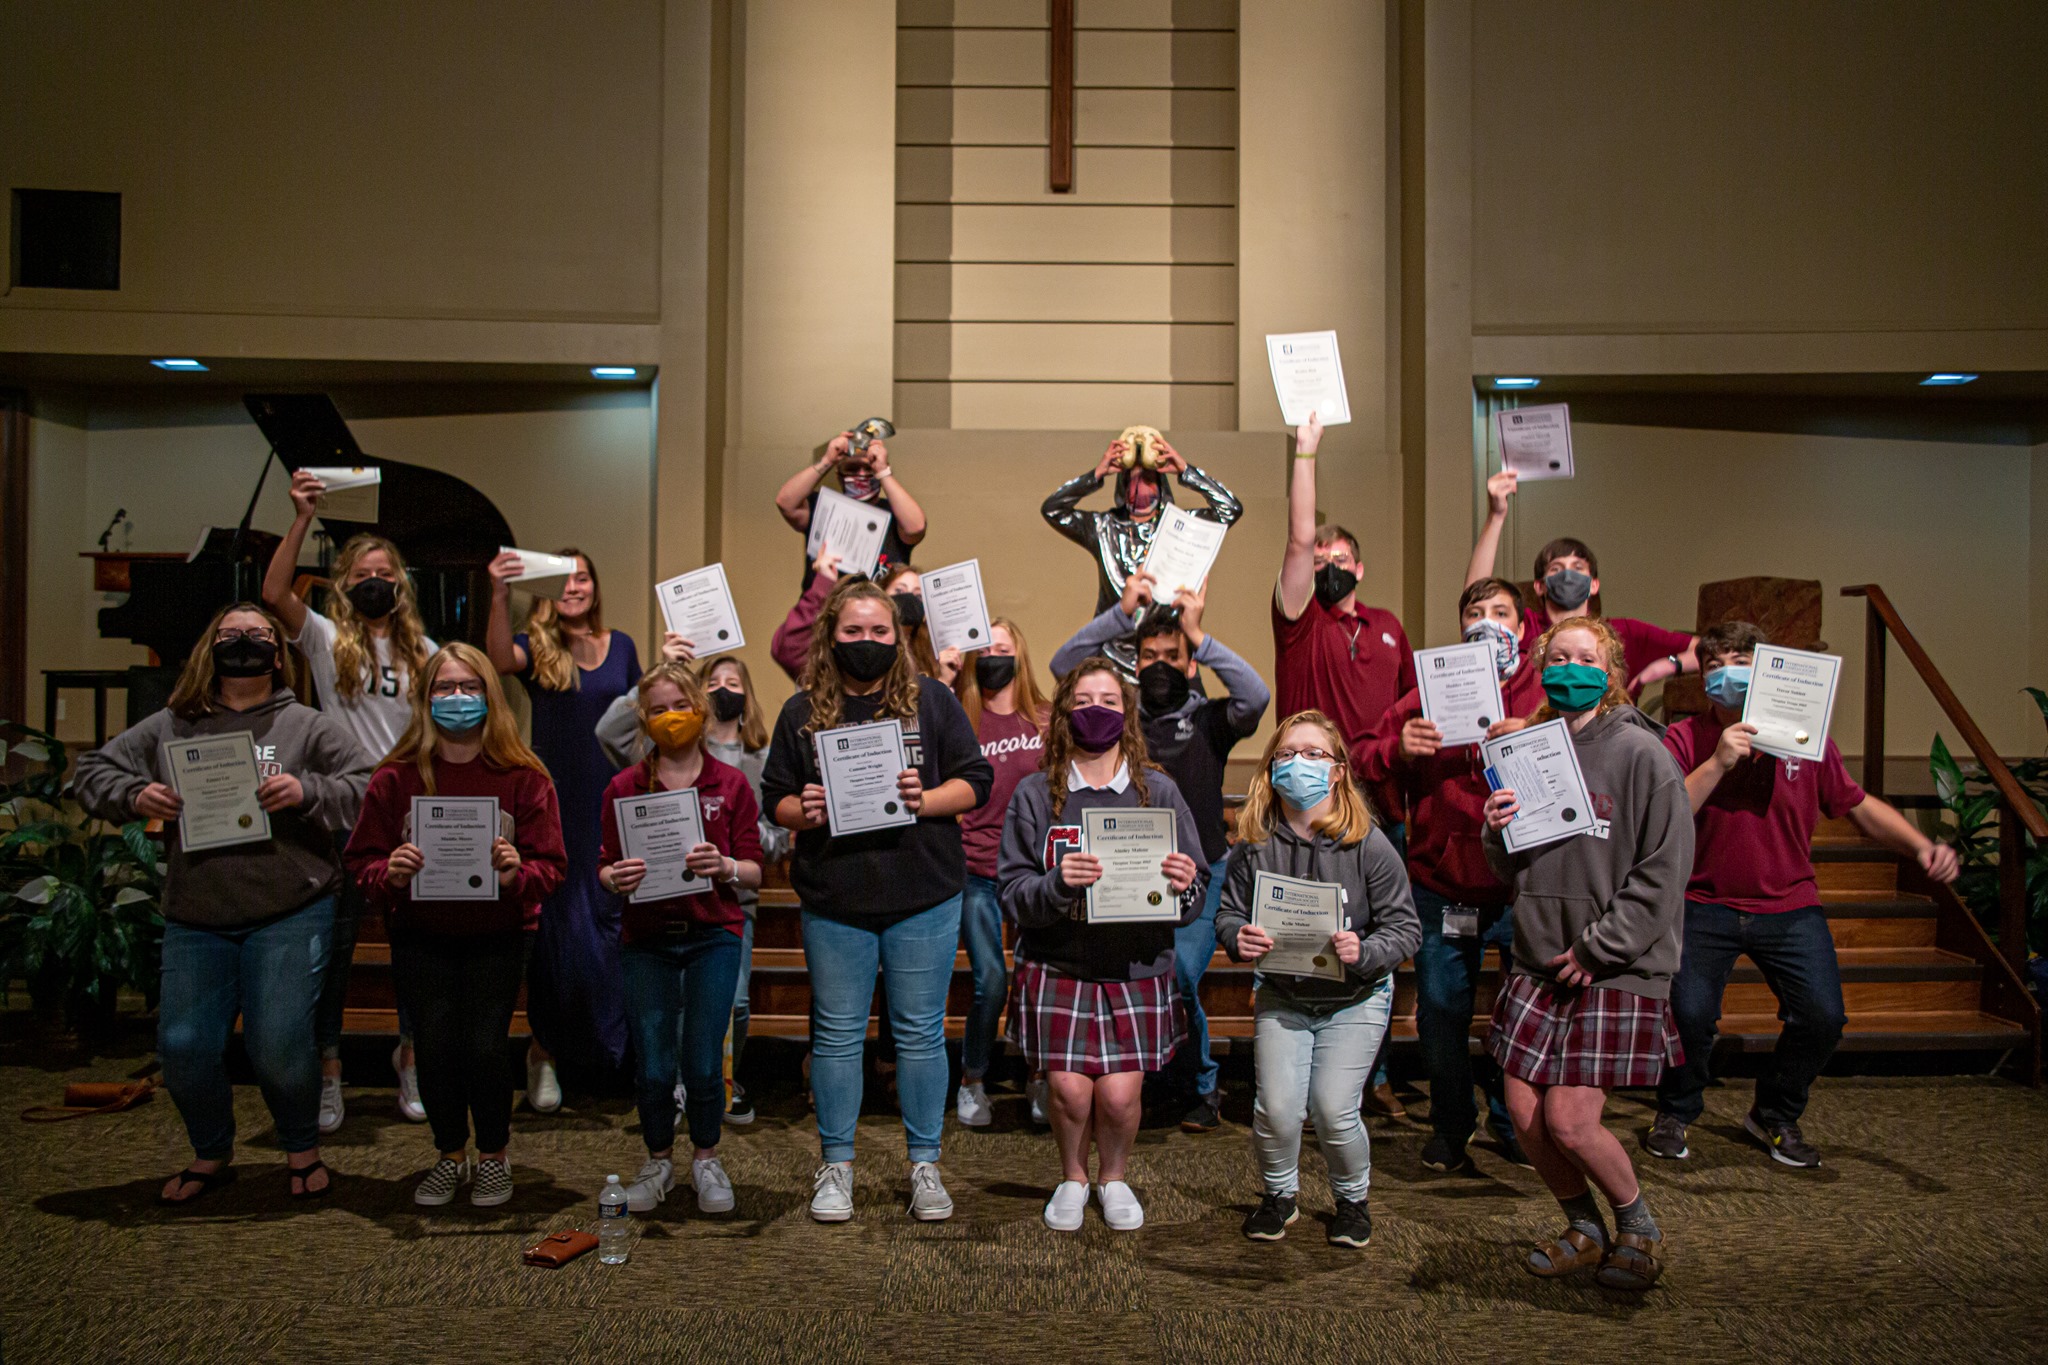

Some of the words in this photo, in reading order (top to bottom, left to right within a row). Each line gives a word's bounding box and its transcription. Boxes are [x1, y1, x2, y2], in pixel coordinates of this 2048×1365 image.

[1762, 672, 1789, 681] Certificate
[1797, 678, 1823, 687] Induction
[833, 754, 860, 762] Certificate
[867, 749, 892, 757] Induction
[1537, 751, 1561, 761] nduction
[183, 765, 212, 774] Certificate
[220, 760, 246, 769] Induction
[631, 821, 658, 829] Certificate
[665, 816, 690, 824] Induction
[1264, 903, 1292, 914] Certificate
